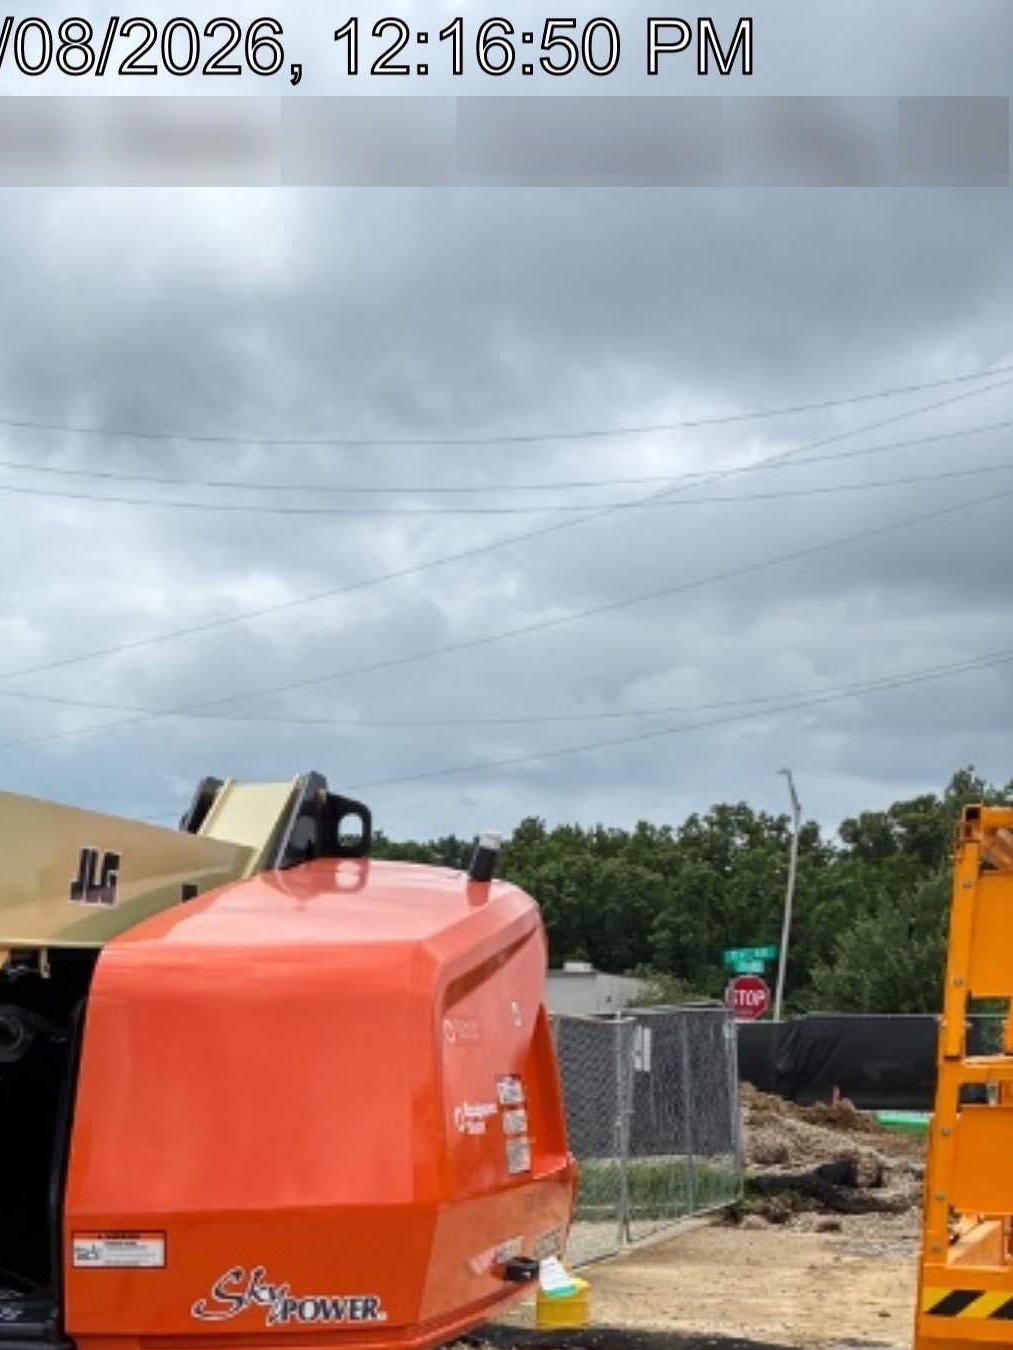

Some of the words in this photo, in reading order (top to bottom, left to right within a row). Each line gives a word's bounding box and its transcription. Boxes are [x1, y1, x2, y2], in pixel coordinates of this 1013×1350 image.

[70, 848, 120, 904] JLG
[191, 1266, 290, 1326] Sky
[278, 1296, 381, 1323] POWER
